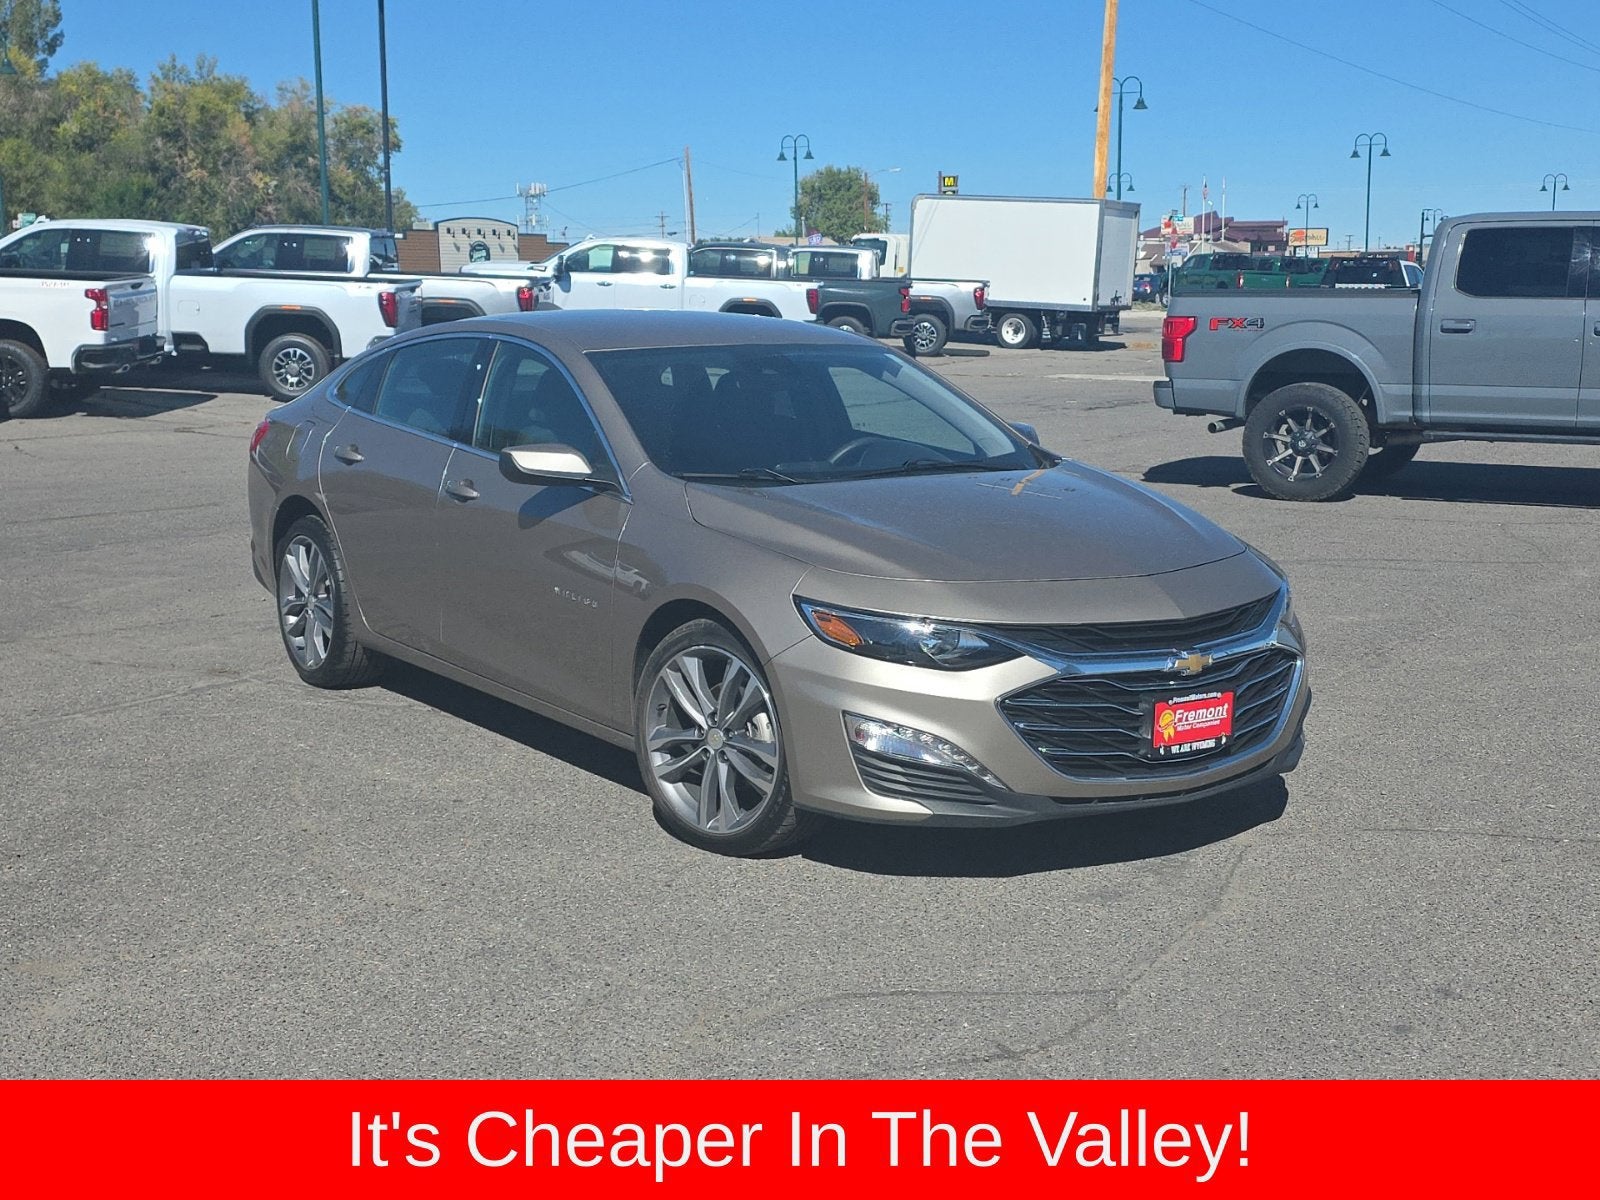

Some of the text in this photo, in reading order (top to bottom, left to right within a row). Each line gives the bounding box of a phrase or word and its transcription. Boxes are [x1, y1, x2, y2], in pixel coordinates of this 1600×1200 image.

[944, 177, 955, 187] M
[1209, 317, 1264, 331] FX4
[1174, 703, 1228, 722] Fremont
[1171, 745, 1180, 754] WE
[1179, 742, 1191, 753] ARE
